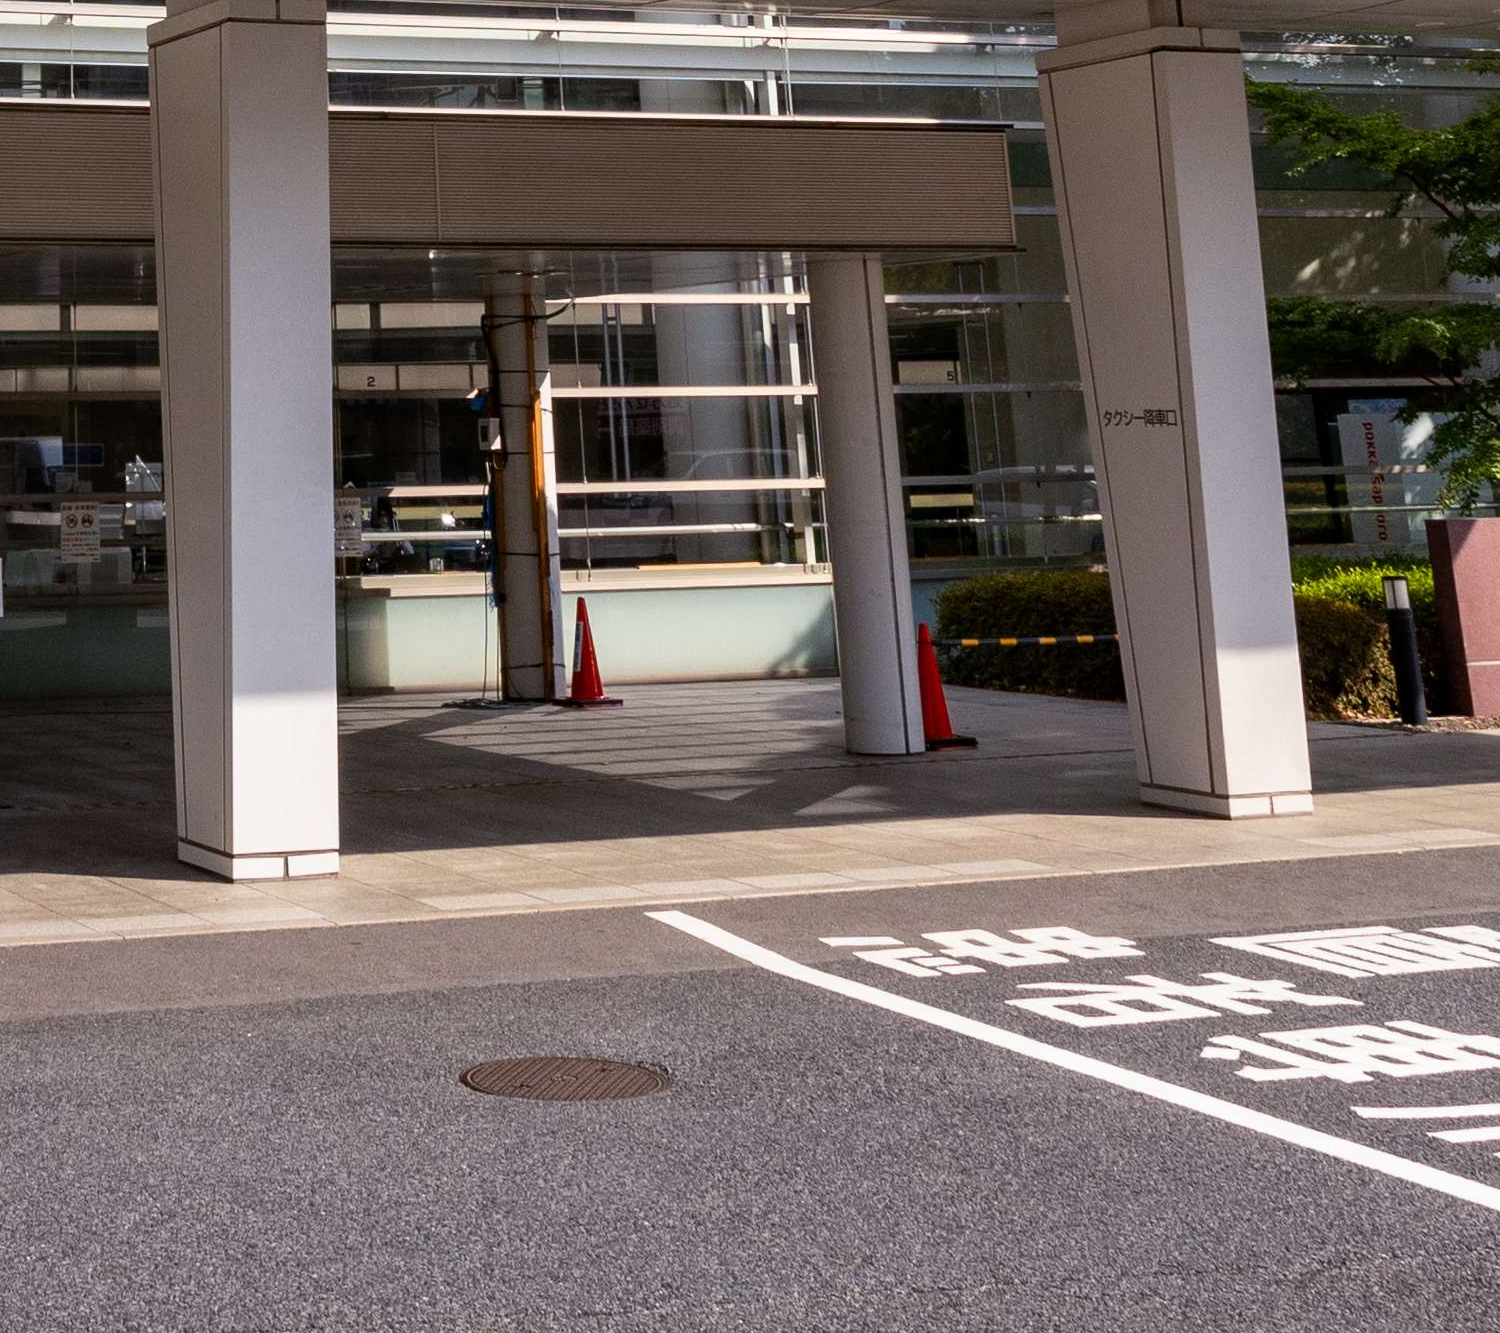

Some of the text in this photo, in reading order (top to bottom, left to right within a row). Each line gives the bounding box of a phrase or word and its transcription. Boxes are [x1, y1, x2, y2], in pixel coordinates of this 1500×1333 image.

[366, 376, 376, 387] 2
[1103, 409, 1177, 428] タクシー降車口
